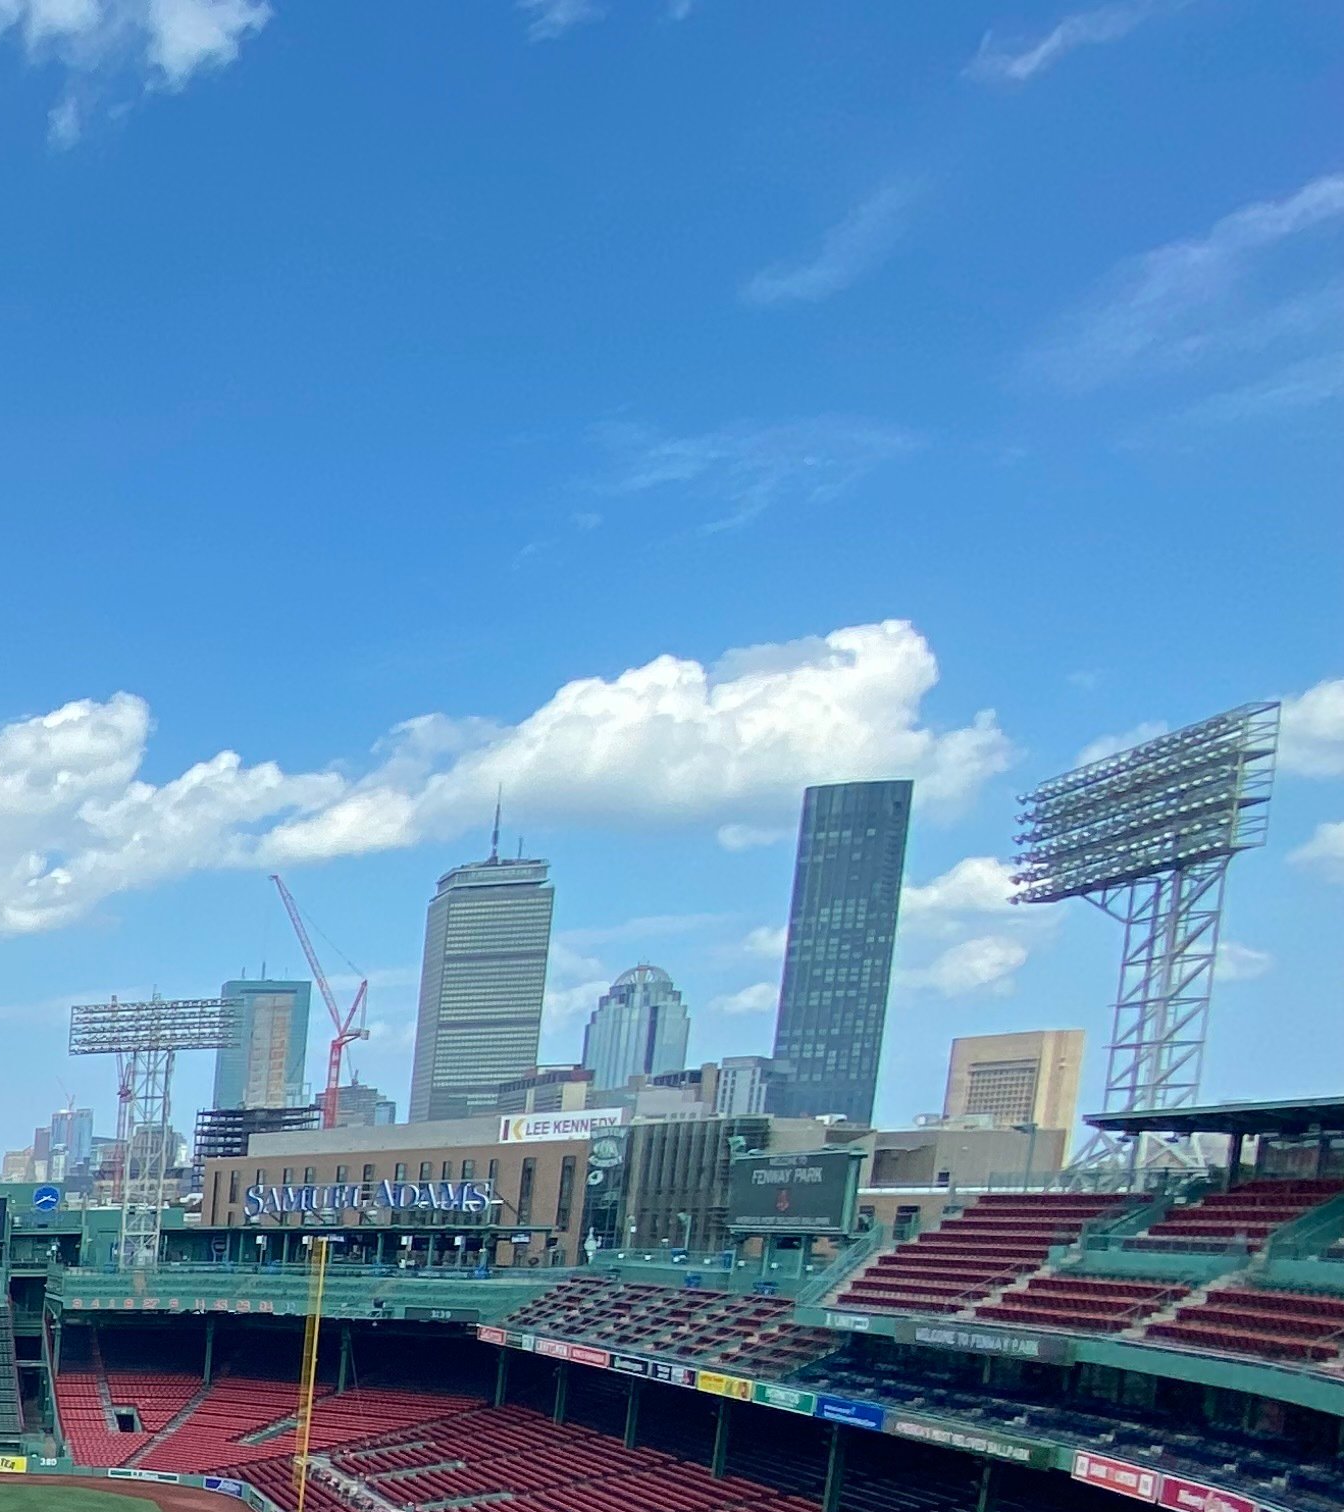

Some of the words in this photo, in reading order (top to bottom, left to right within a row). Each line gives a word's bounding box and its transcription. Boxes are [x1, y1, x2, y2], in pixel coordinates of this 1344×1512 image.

[525, 1121, 551, 1136] LEE
[752, 1169, 792, 1185] FENWAY
[794, 1167, 823, 1183] PARK
[243, 1184, 369, 1217] SAMUEL
[373, 1179, 491, 1213] ADAMS
[0, 1458, 16, 1470] TEA
